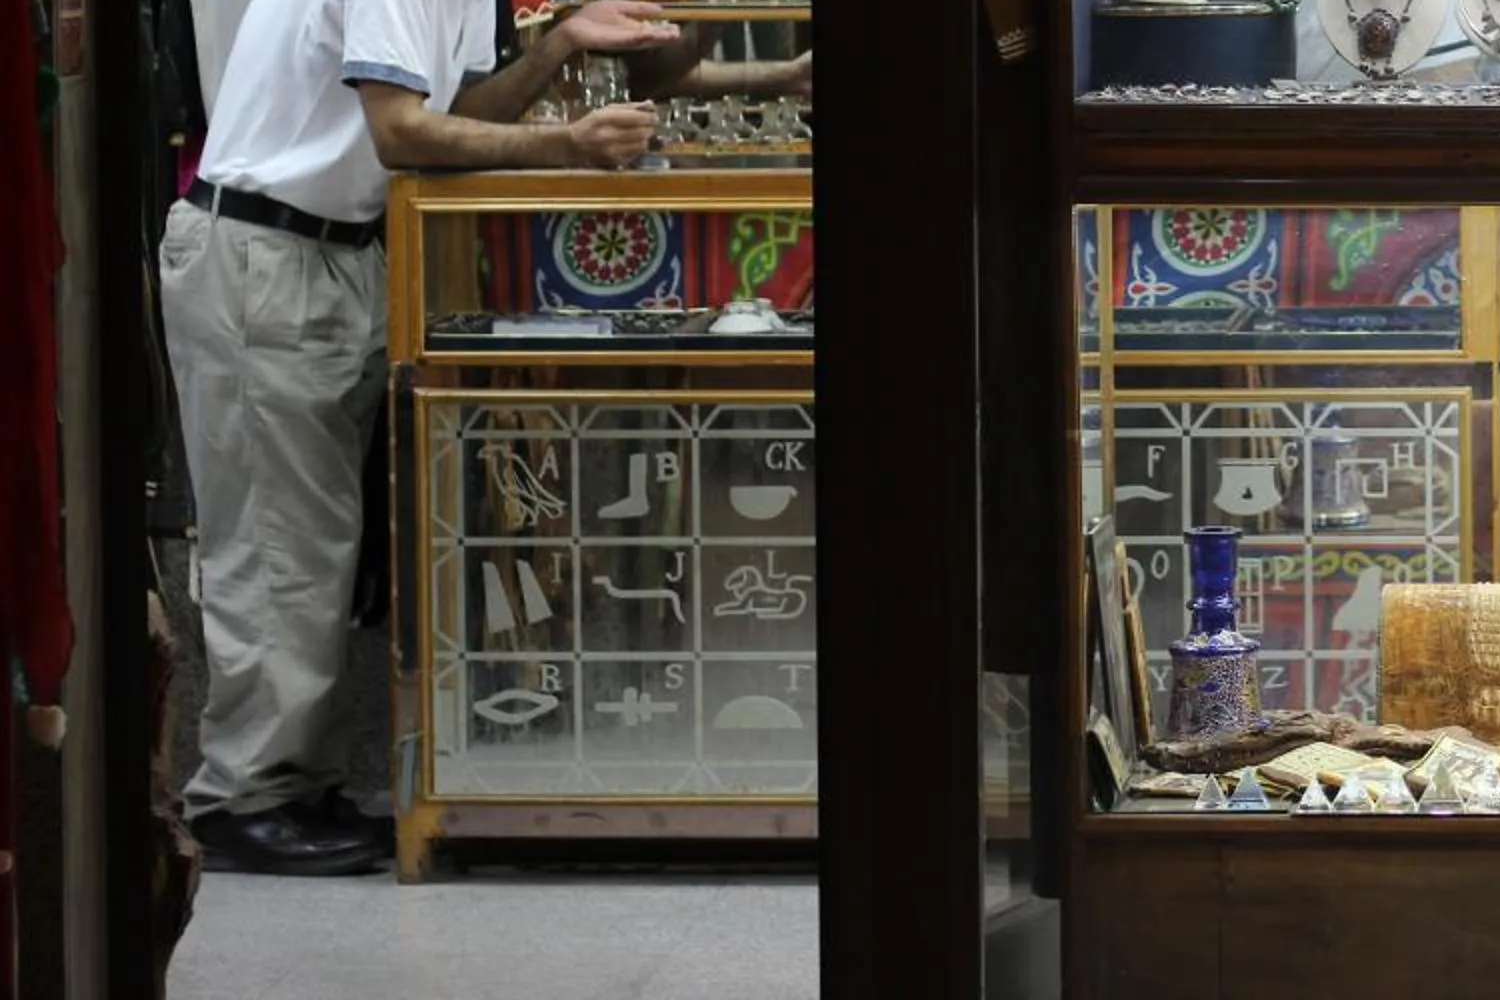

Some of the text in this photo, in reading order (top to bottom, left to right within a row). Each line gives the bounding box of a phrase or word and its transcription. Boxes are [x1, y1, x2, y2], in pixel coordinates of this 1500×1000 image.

[540, 446, 560, 480] A
[655, 452, 681, 482] B
[765, 442, 806, 472] CK
[1147, 445, 1166, 479] F
[1280, 441, 1300, 470] G
[1391, 442, 1416, 469] H
[551, 552, 561, 583] I
[665, 552, 684, 581] J
[767, 550, 787, 578] L
[540, 664, 563, 691] R
[665, 665, 684, 689] S
[780, 665, 811, 691] T
[1262, 667, 1288, 689] Z
